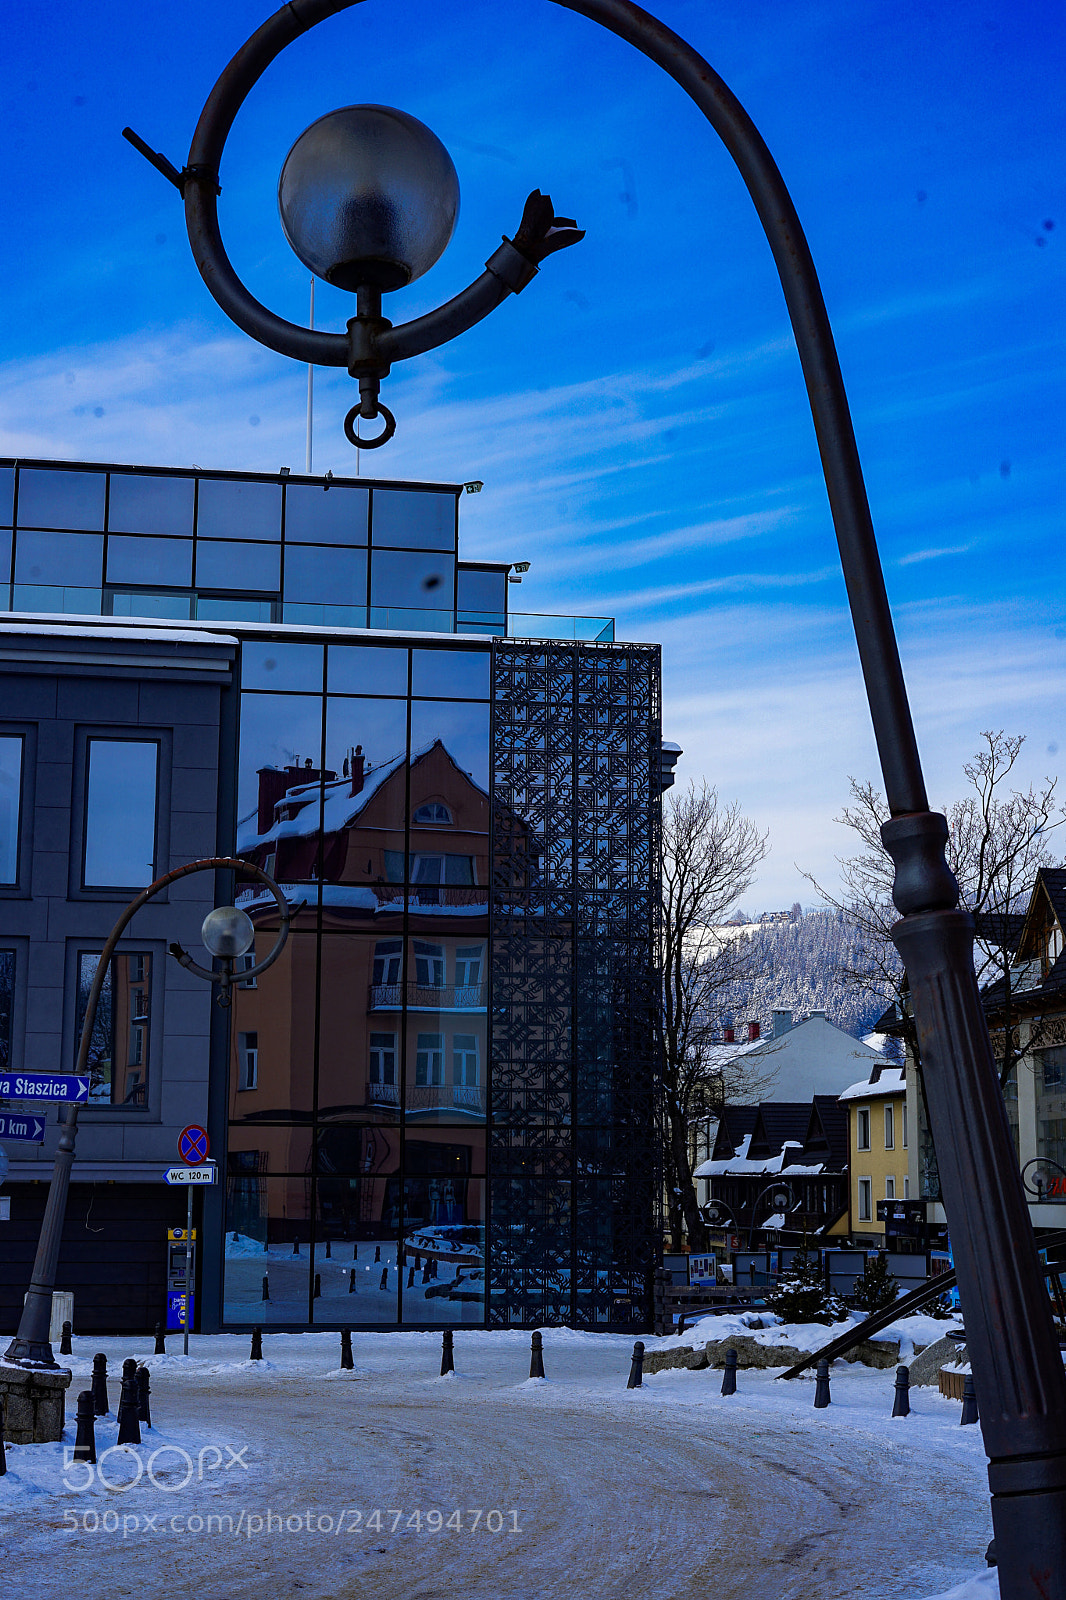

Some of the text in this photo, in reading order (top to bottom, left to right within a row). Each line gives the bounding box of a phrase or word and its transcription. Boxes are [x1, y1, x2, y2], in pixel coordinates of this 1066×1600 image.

[15, 1077, 68, 1097] Staszica
[8, 1118, 28, 1136] km
[170, 1171, 184, 1181] WC
[188, 1171, 201, 1180] 120
